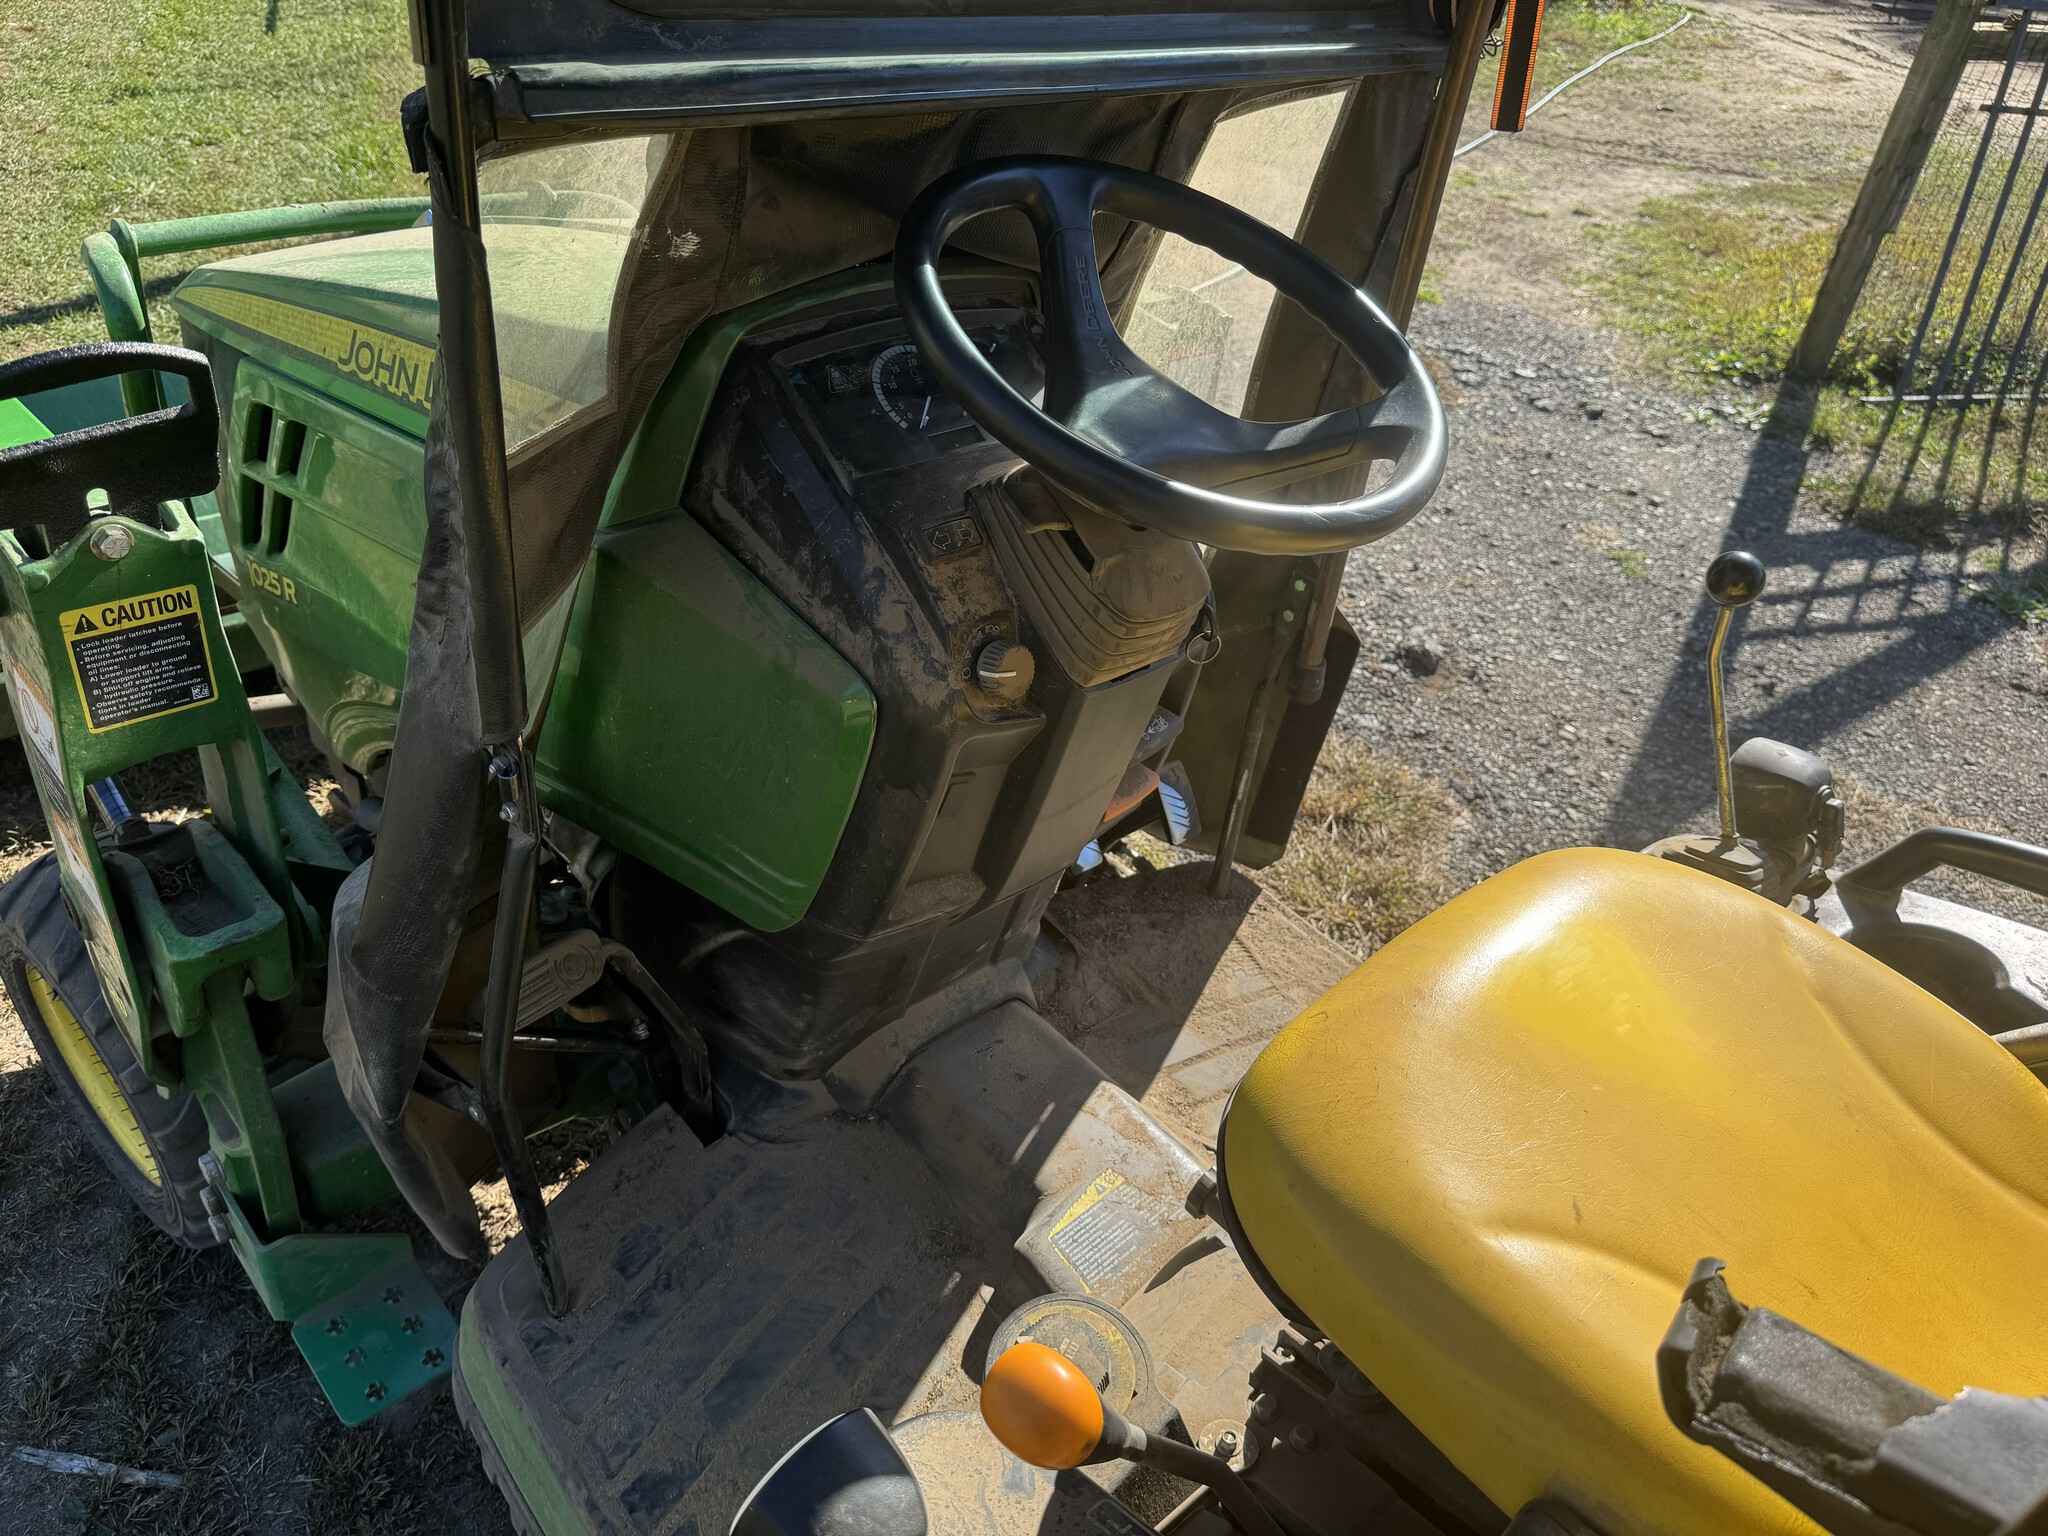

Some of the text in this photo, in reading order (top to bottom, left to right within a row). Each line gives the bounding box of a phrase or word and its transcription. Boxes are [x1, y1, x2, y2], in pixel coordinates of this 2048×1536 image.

[1076, 254, 1102, 332] DEERE
[338, 329, 419, 396] JOHN
[891, 365, 900, 374] 15
[906, 358, 917, 367] 20
[887, 381, 898, 390] 10
[101, 590, 193, 627] CAUTION
[80, 622, 182, 649] Lock loader latches before
[82, 644, 122, 656] operating.
[84, 634, 186, 662] Before servicing, adjusting
[86, 655, 127, 669] equipment
[139, 639, 191, 656] disconnecting
[88, 664, 120, 676] oil lines:
[100, 670, 124, 680] Lower
[125, 664, 149, 674] loader
[161, 654, 187, 666] ground
[103, 684, 121, 693] Shut
[135, 675, 160, 685] engine
[177, 664, 201, 674] relieve
[111, 672, 141, 684] support
[154, 665, 176, 673] arms.
[96, 678, 204, 708] Observe safety recommenda-
[104, 678, 175, 700] hydraulic pressure.
[98, 706, 117, 714] tions
[128, 697, 151, 706] loader
[100, 708, 138, 721] operator's
[140, 699, 169, 710] manual.
